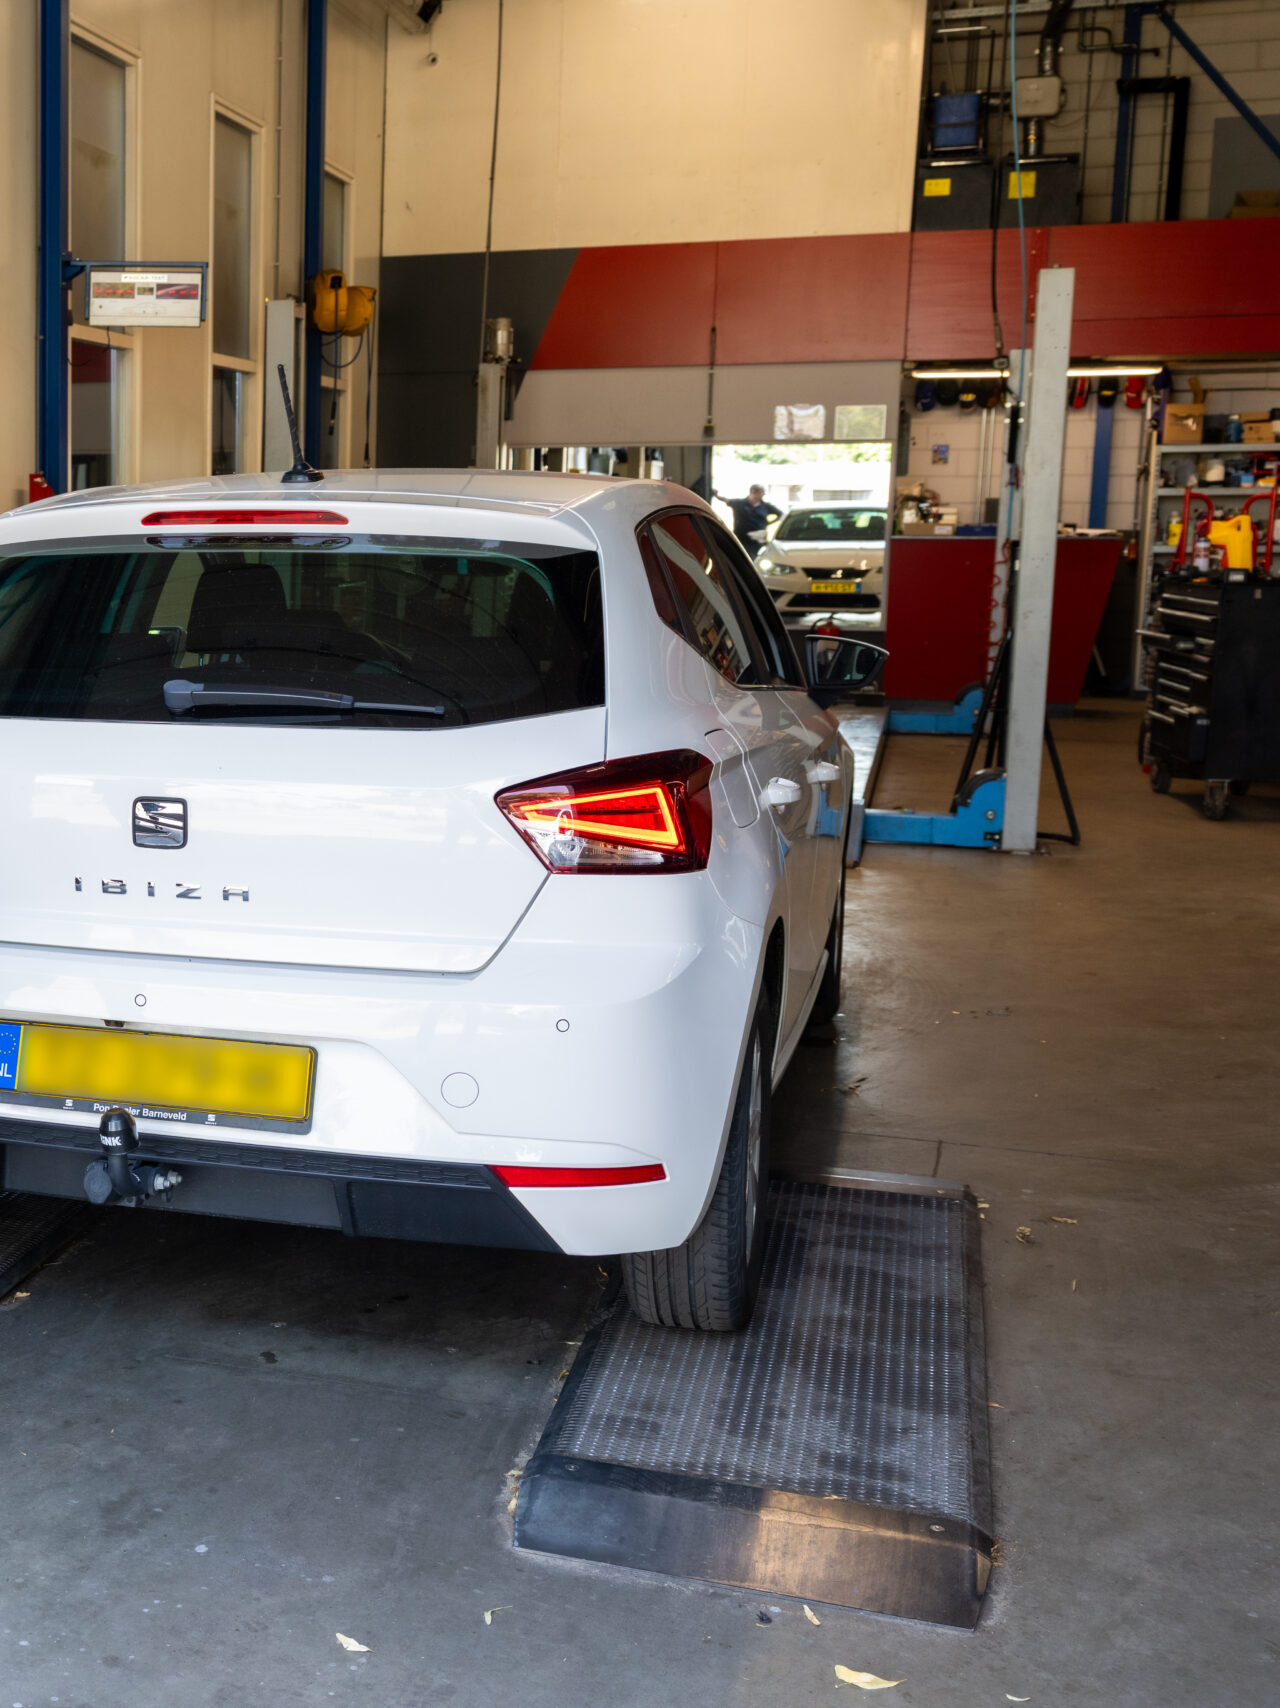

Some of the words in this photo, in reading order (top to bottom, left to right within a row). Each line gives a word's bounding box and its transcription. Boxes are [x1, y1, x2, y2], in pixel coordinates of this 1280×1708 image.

[74, 876, 250, 902] IBIZA
[93, 1103, 110, 1113] Pon
[142, 1108, 187, 1121] Barneveld
